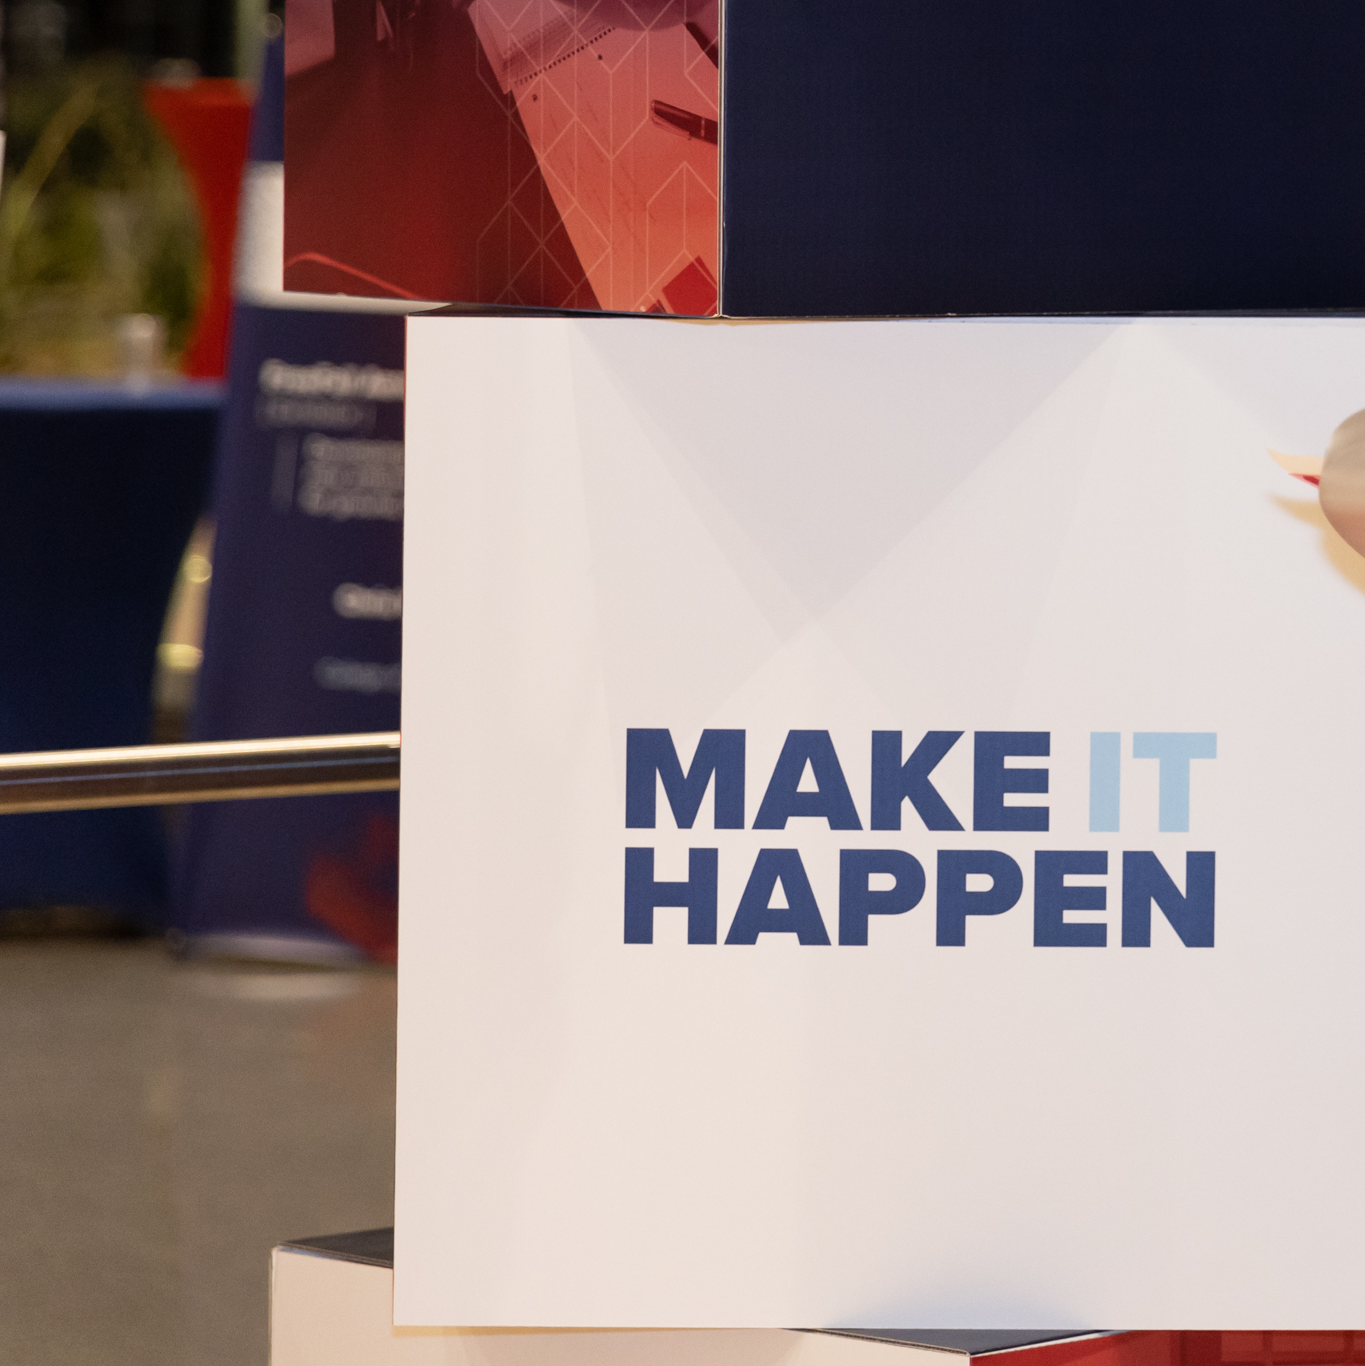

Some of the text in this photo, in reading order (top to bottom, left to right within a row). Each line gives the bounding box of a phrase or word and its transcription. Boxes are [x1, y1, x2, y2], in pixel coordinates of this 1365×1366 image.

[625, 728, 1218, 833] MAKE IT
[623, 847, 1216, 948] HAPPEN
